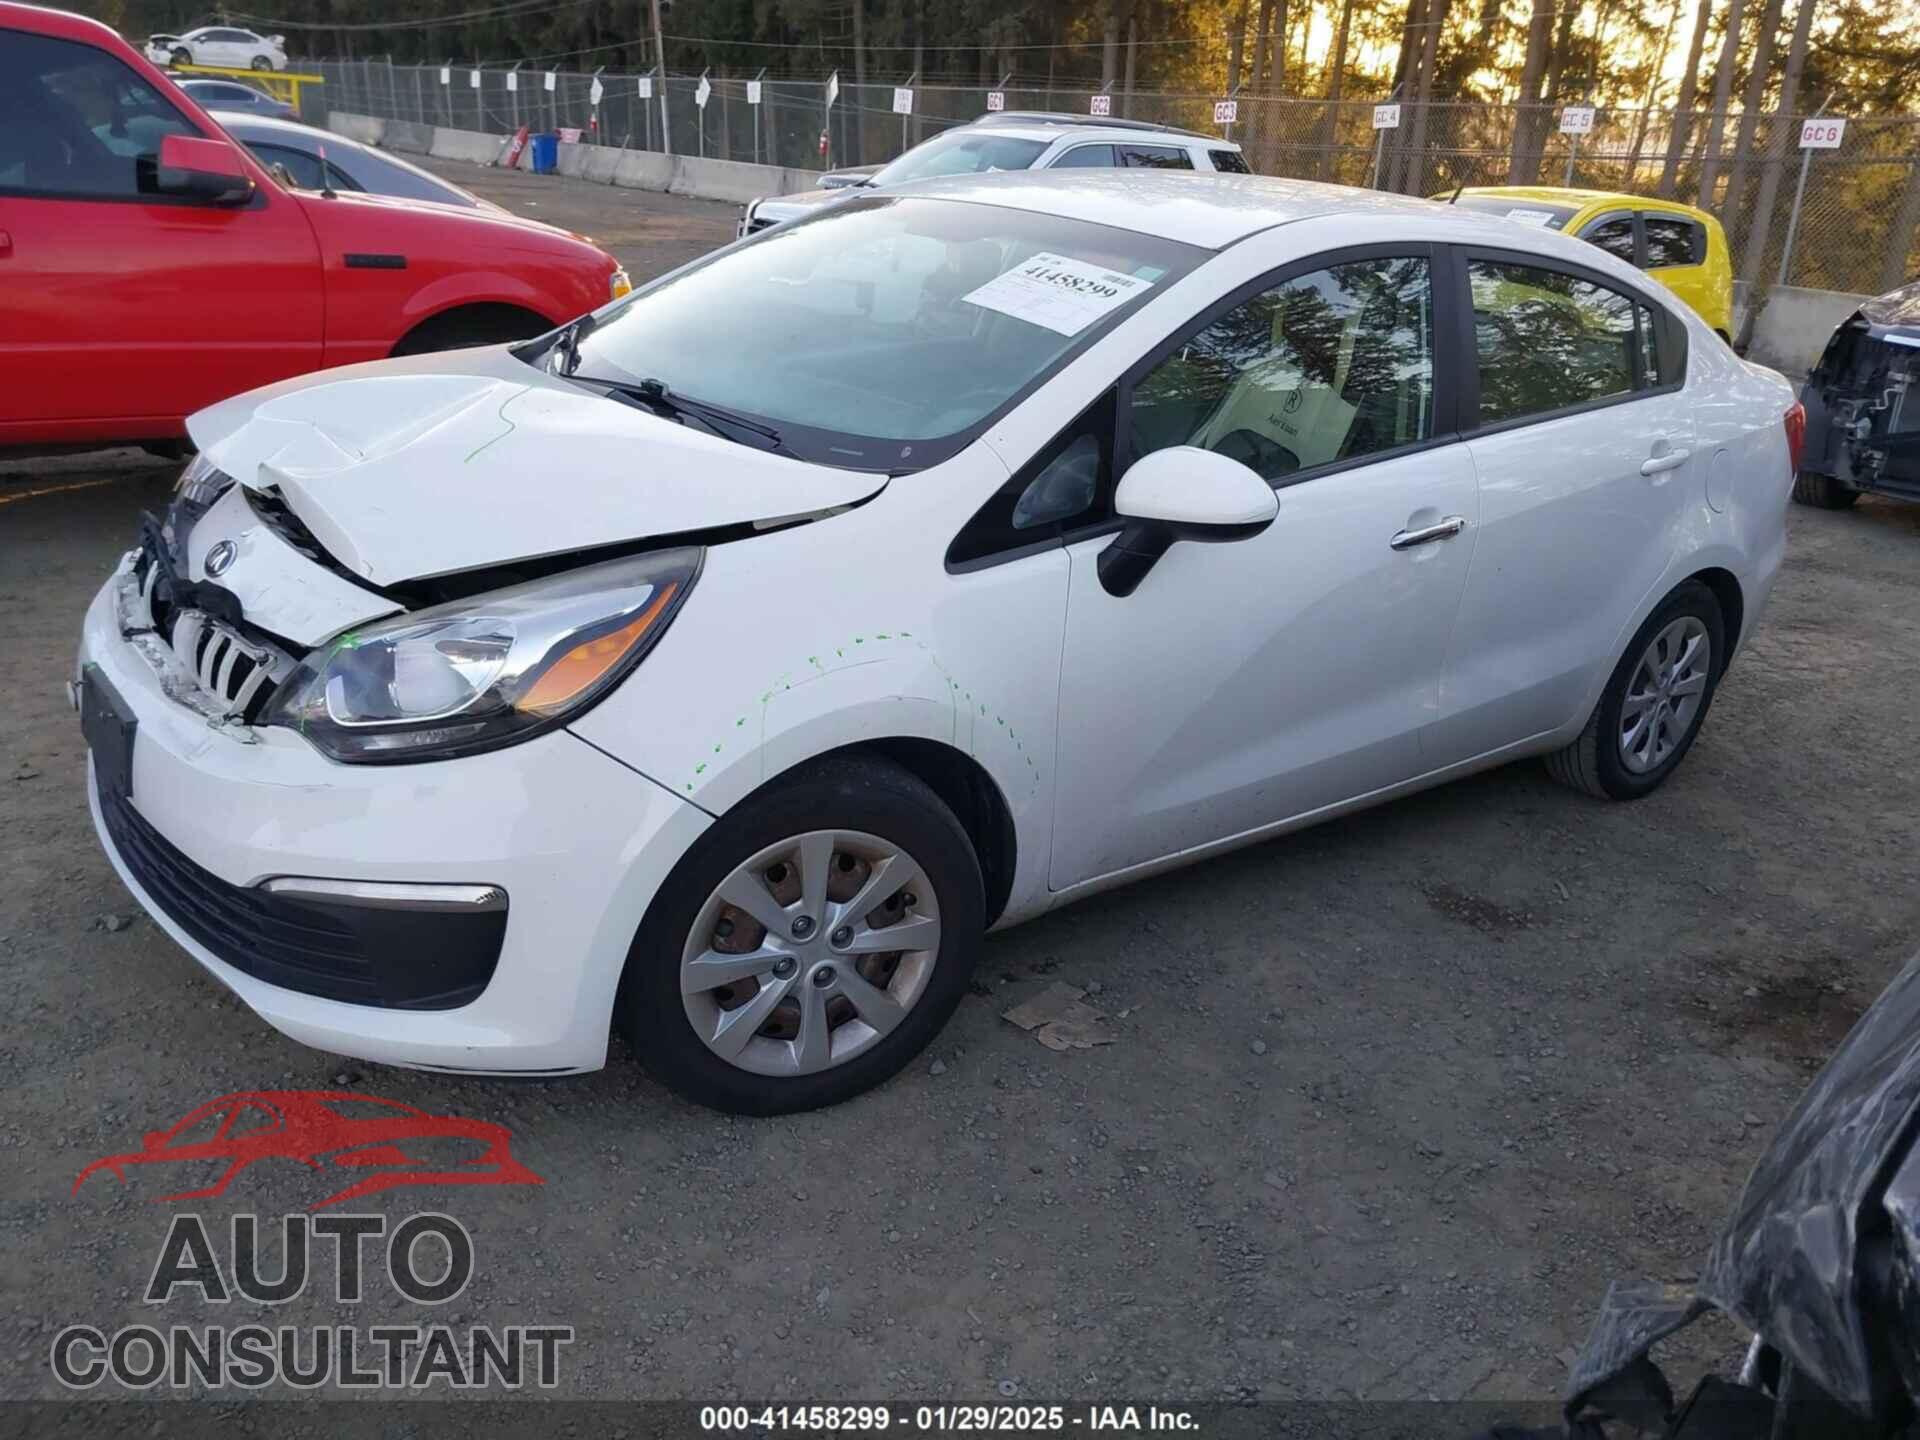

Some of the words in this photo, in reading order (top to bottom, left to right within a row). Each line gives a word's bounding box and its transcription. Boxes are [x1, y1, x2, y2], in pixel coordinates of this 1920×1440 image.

[1093, 98, 1108, 112] GC2
[1216, 104, 1234, 120] GC3
[1025, 266, 1118, 298] 41458299
